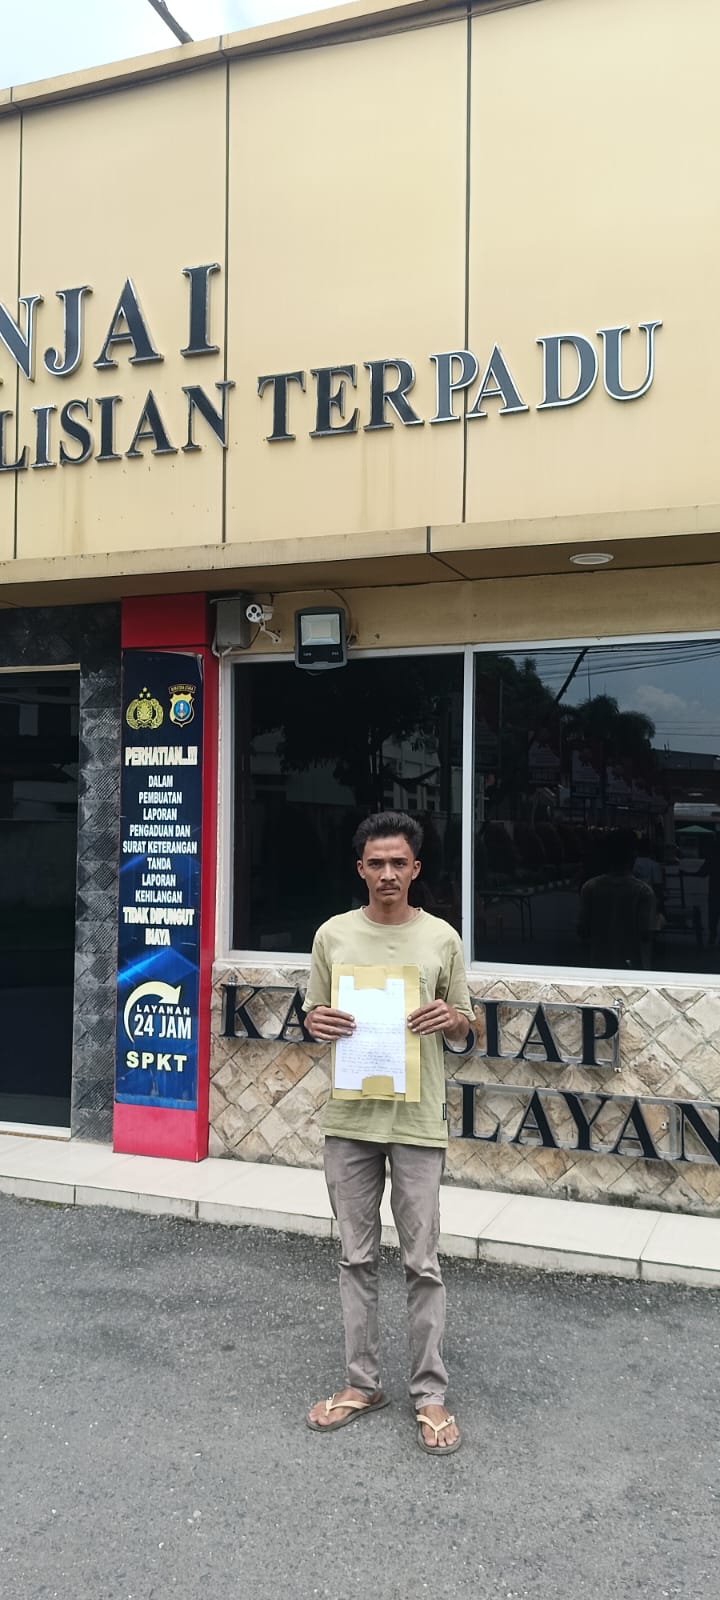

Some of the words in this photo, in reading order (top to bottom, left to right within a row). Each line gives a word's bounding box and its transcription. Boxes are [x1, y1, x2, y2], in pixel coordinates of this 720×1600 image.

[257, 320, 663, 442] TERPADU
[148, 775, 174, 788] DALAM
[138, 791, 183, 805] PEMBUATAN
[143, 807, 178, 821] LAPORAN
[129, 824, 174, 838] PENGADUAN
[175, 825, 191, 838] DAN
[122, 840, 147, 853] SURAT
[147, 841, 198, 854] KETERANGAN
[146, 857, 172, 870] TANDA
[142, 873, 176, 887] LAPORAN
[135, 889, 183, 904] KEHILANGAN
[122, 906, 149, 924] TIDAK
[149, 907, 195, 926] DIPUNGUT
[144, 927, 171, 946] BIAYA
[136, 1004, 191, 1016] LAYANAN
[134, 1014, 155, 1037] 24
[158, 1015, 192, 1040] JAM
[126, 1050, 188, 1073] SPKT
